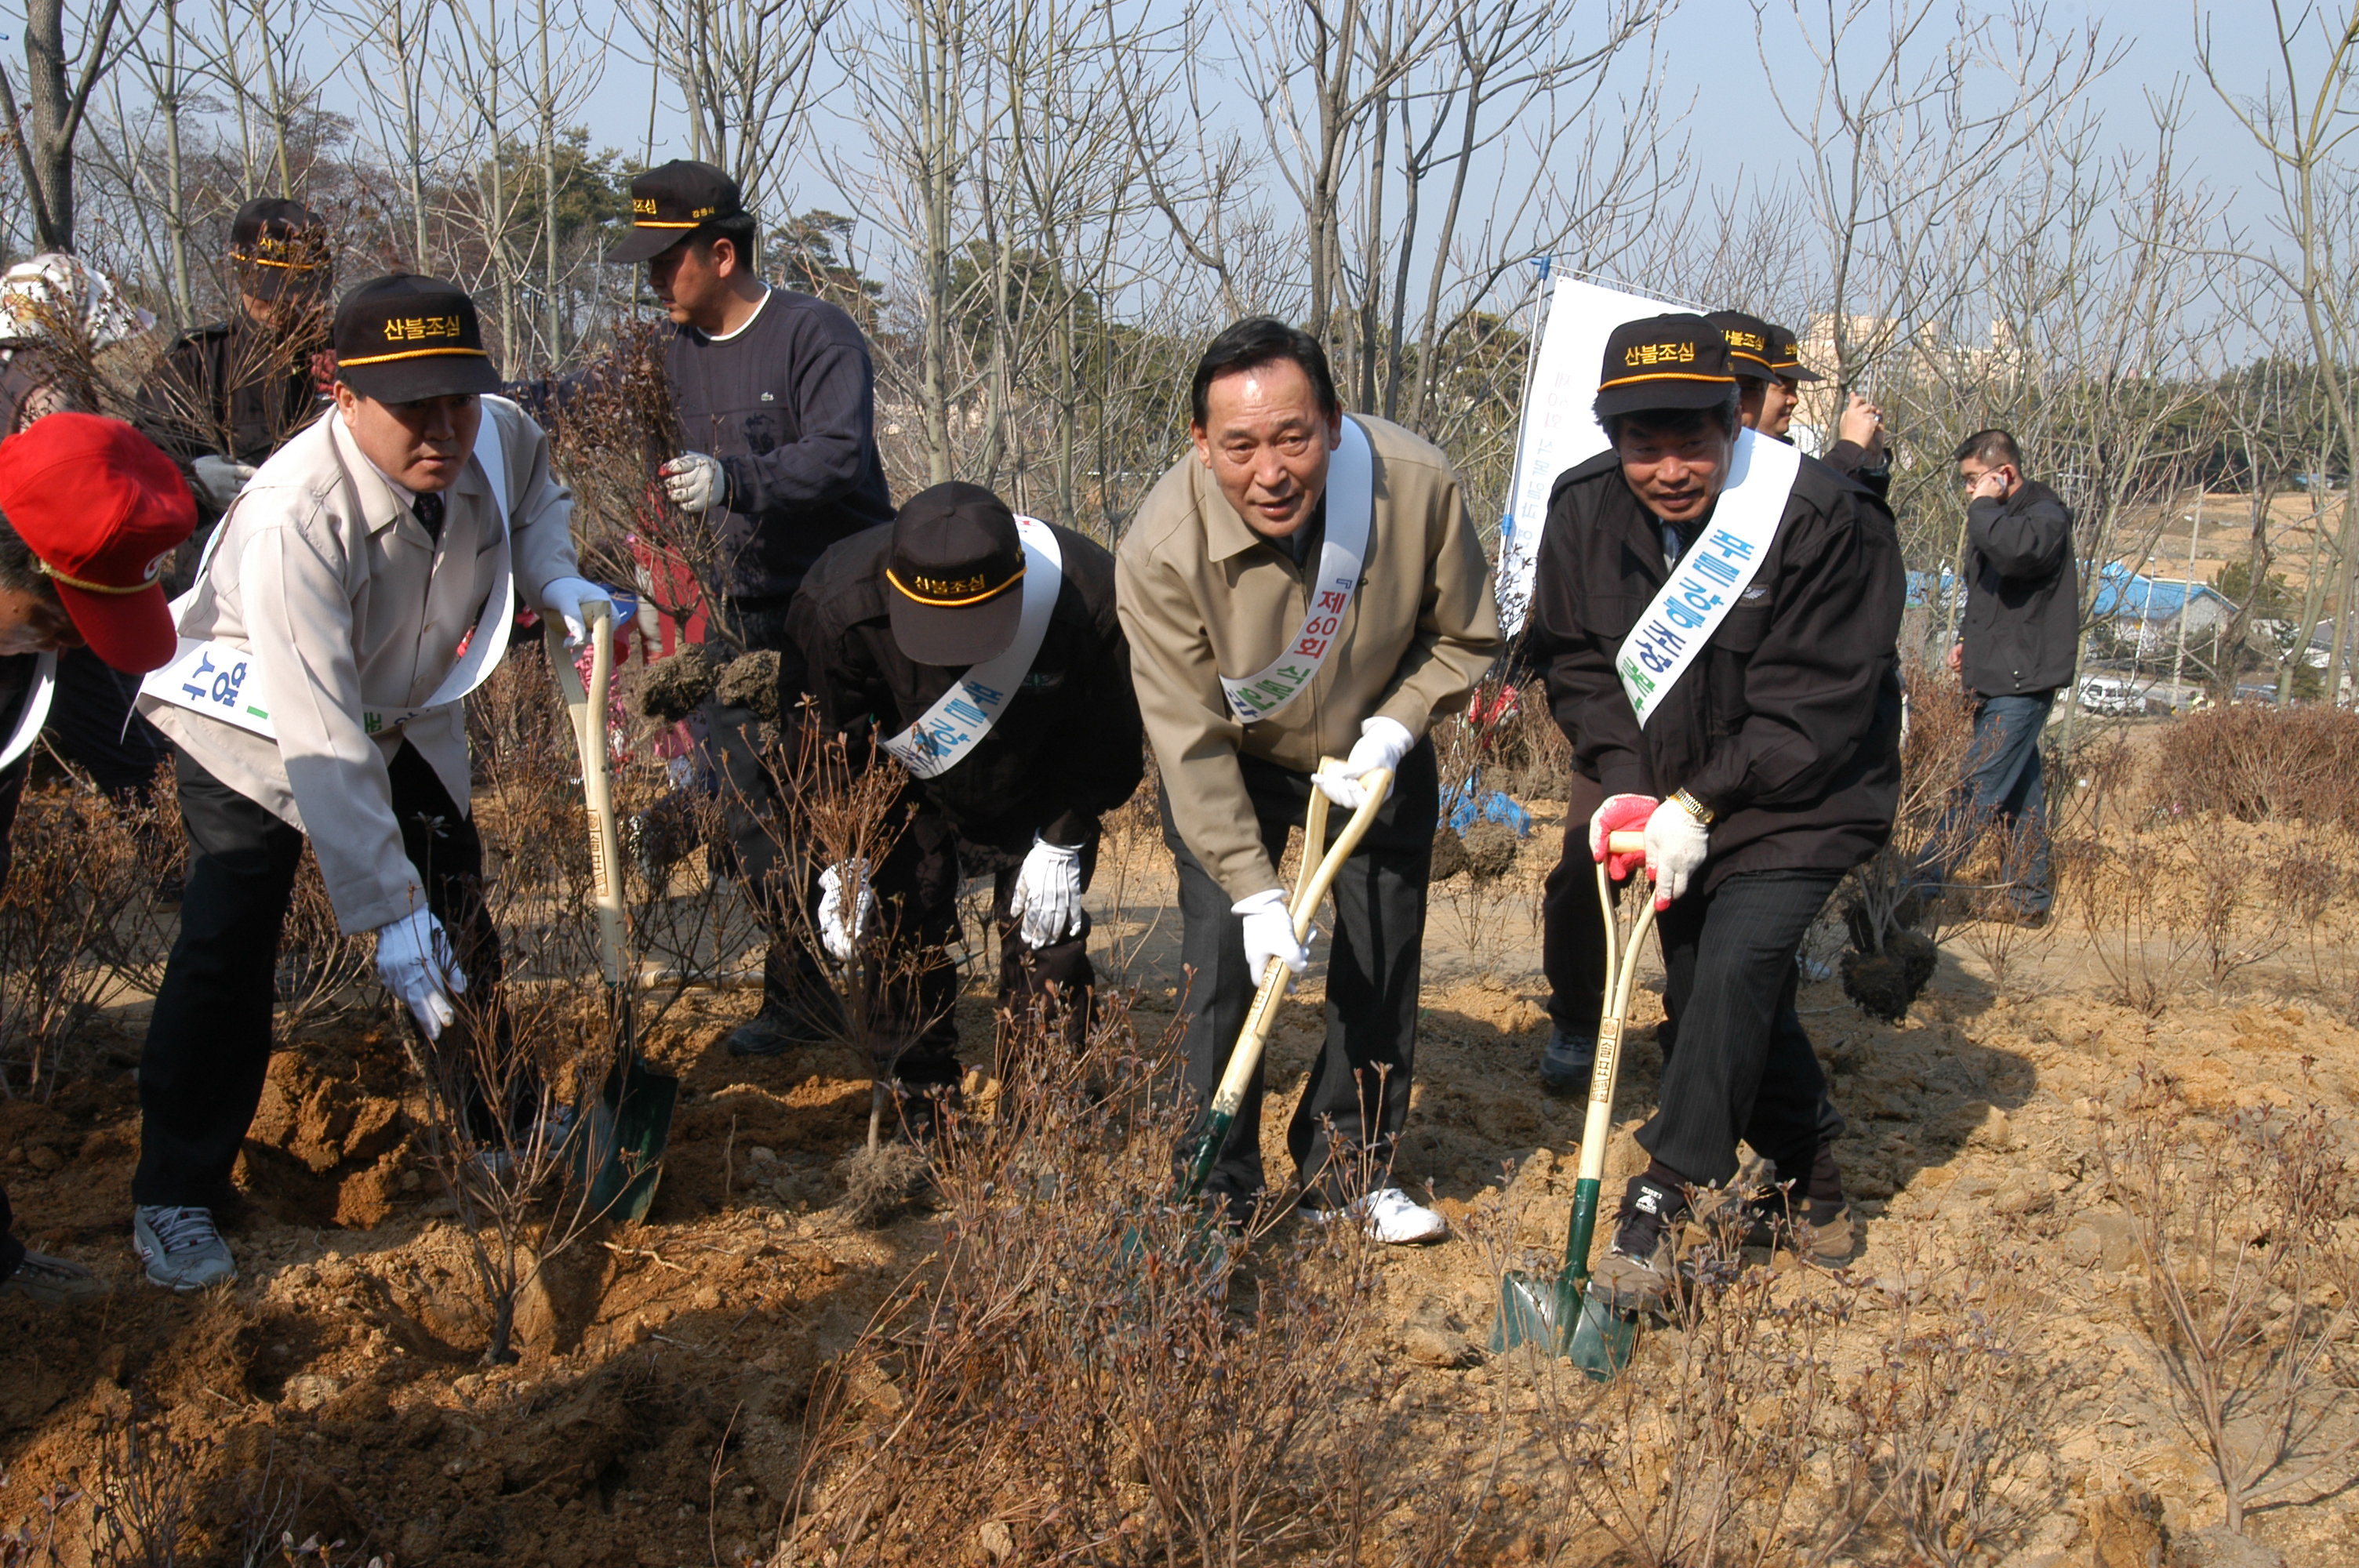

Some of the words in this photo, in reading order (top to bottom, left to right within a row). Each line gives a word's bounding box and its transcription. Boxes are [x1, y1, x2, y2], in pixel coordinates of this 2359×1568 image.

[383, 314, 461, 341] 산불조심
[1624, 341, 1696, 367] 산불조심
[914, 574, 986, 595] 산불조심
[1692, 529, 1755, 588] 푸른
[1662, 576, 1725, 630] 강릉
[1634, 619, 1687, 674] 조성
[181, 650, 249, 706] 행사
[943, 681, 1005, 728] 푸른
[1226, 665, 1312, 718] 식목일과
